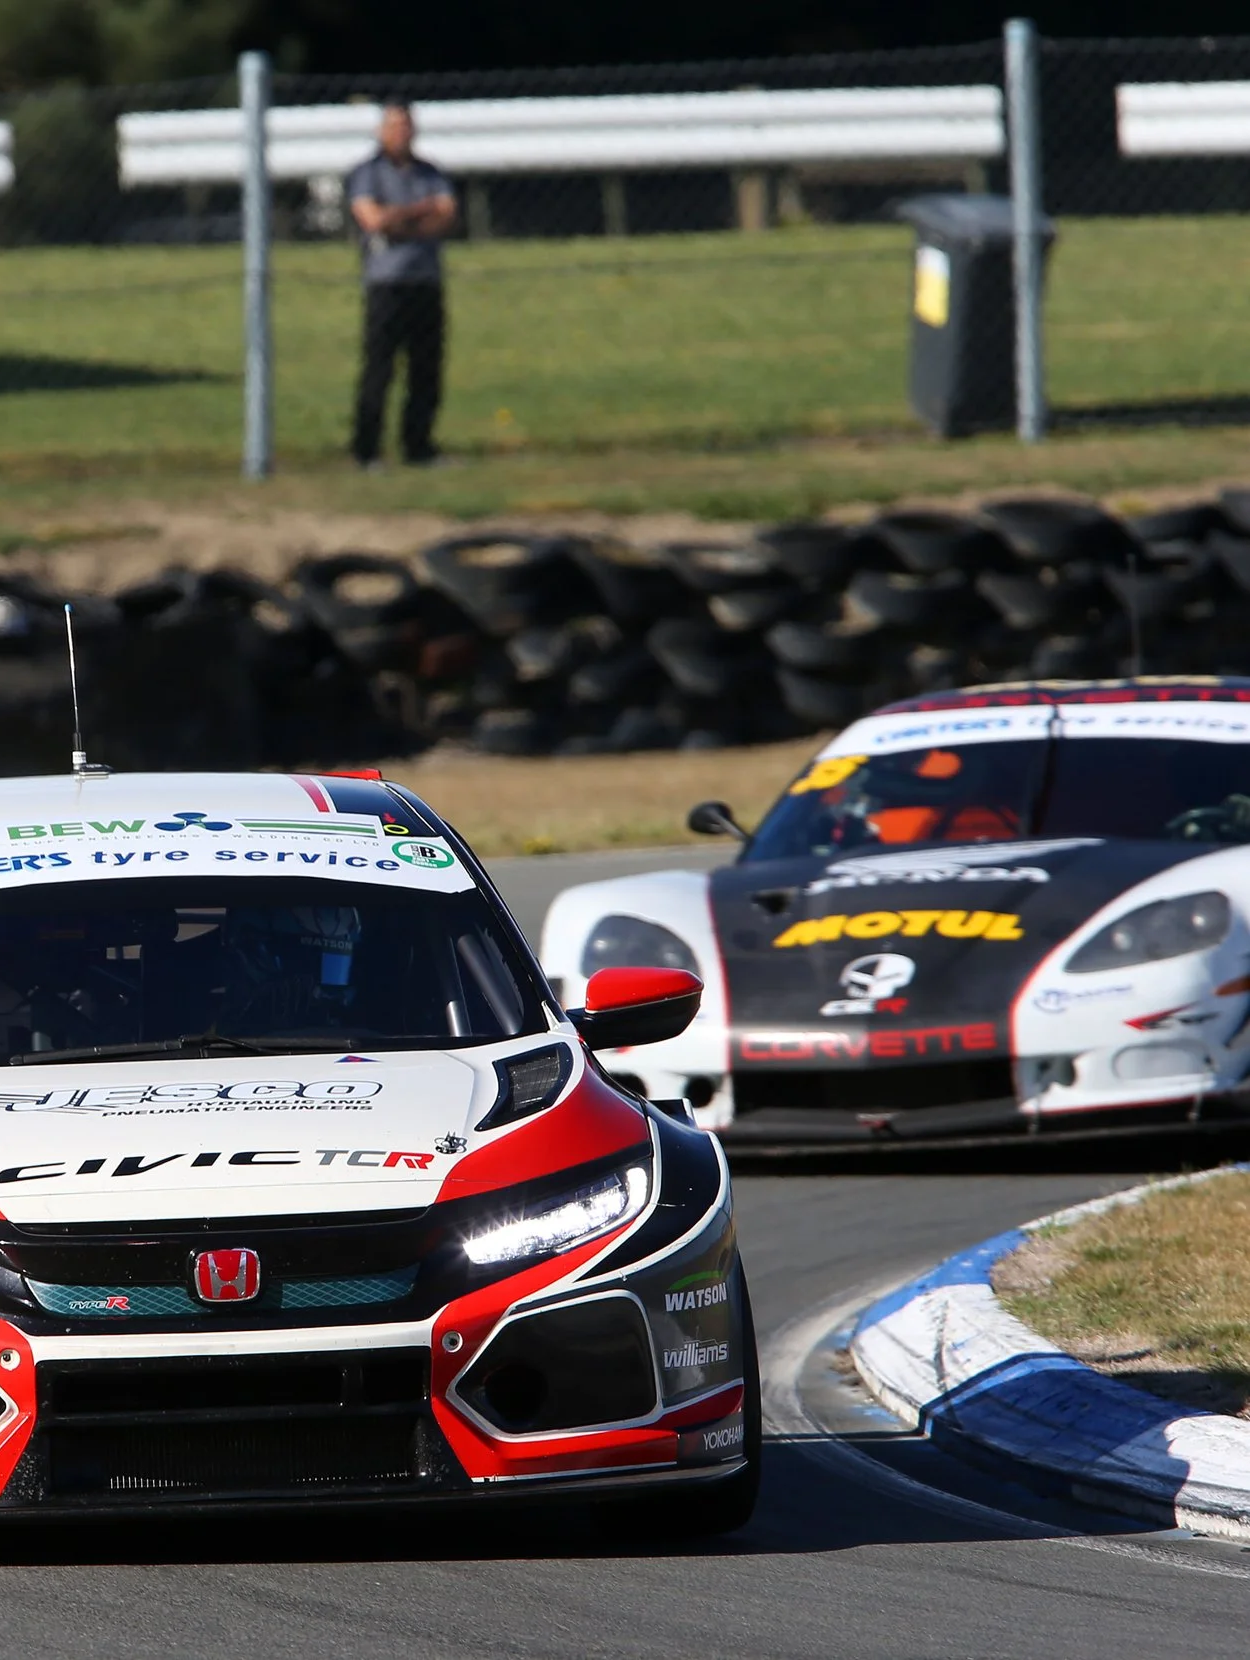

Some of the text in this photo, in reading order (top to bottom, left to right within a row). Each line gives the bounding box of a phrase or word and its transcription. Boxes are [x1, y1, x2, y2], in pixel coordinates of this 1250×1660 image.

[7, 820, 146, 840] BEW
[232, 833, 311, 841] WELDING
[92, 850, 190, 866] tyre
[215, 850, 400, 871] service
[772, 910, 1025, 947] MOTUL
[300, 936, 353, 950] WATSON
[739, 1022, 998, 1061] CORVETTE
[5, 1080, 383, 1112] JESCO
[187, 1099, 314, 1107] HYDRAULIC
[102, 1106, 234, 1117] PNEUMATIC
[315, 1150, 435, 1169] TCR
[665, 1282, 727, 1312] WATSON
[663, 1342, 728, 1368] williams
